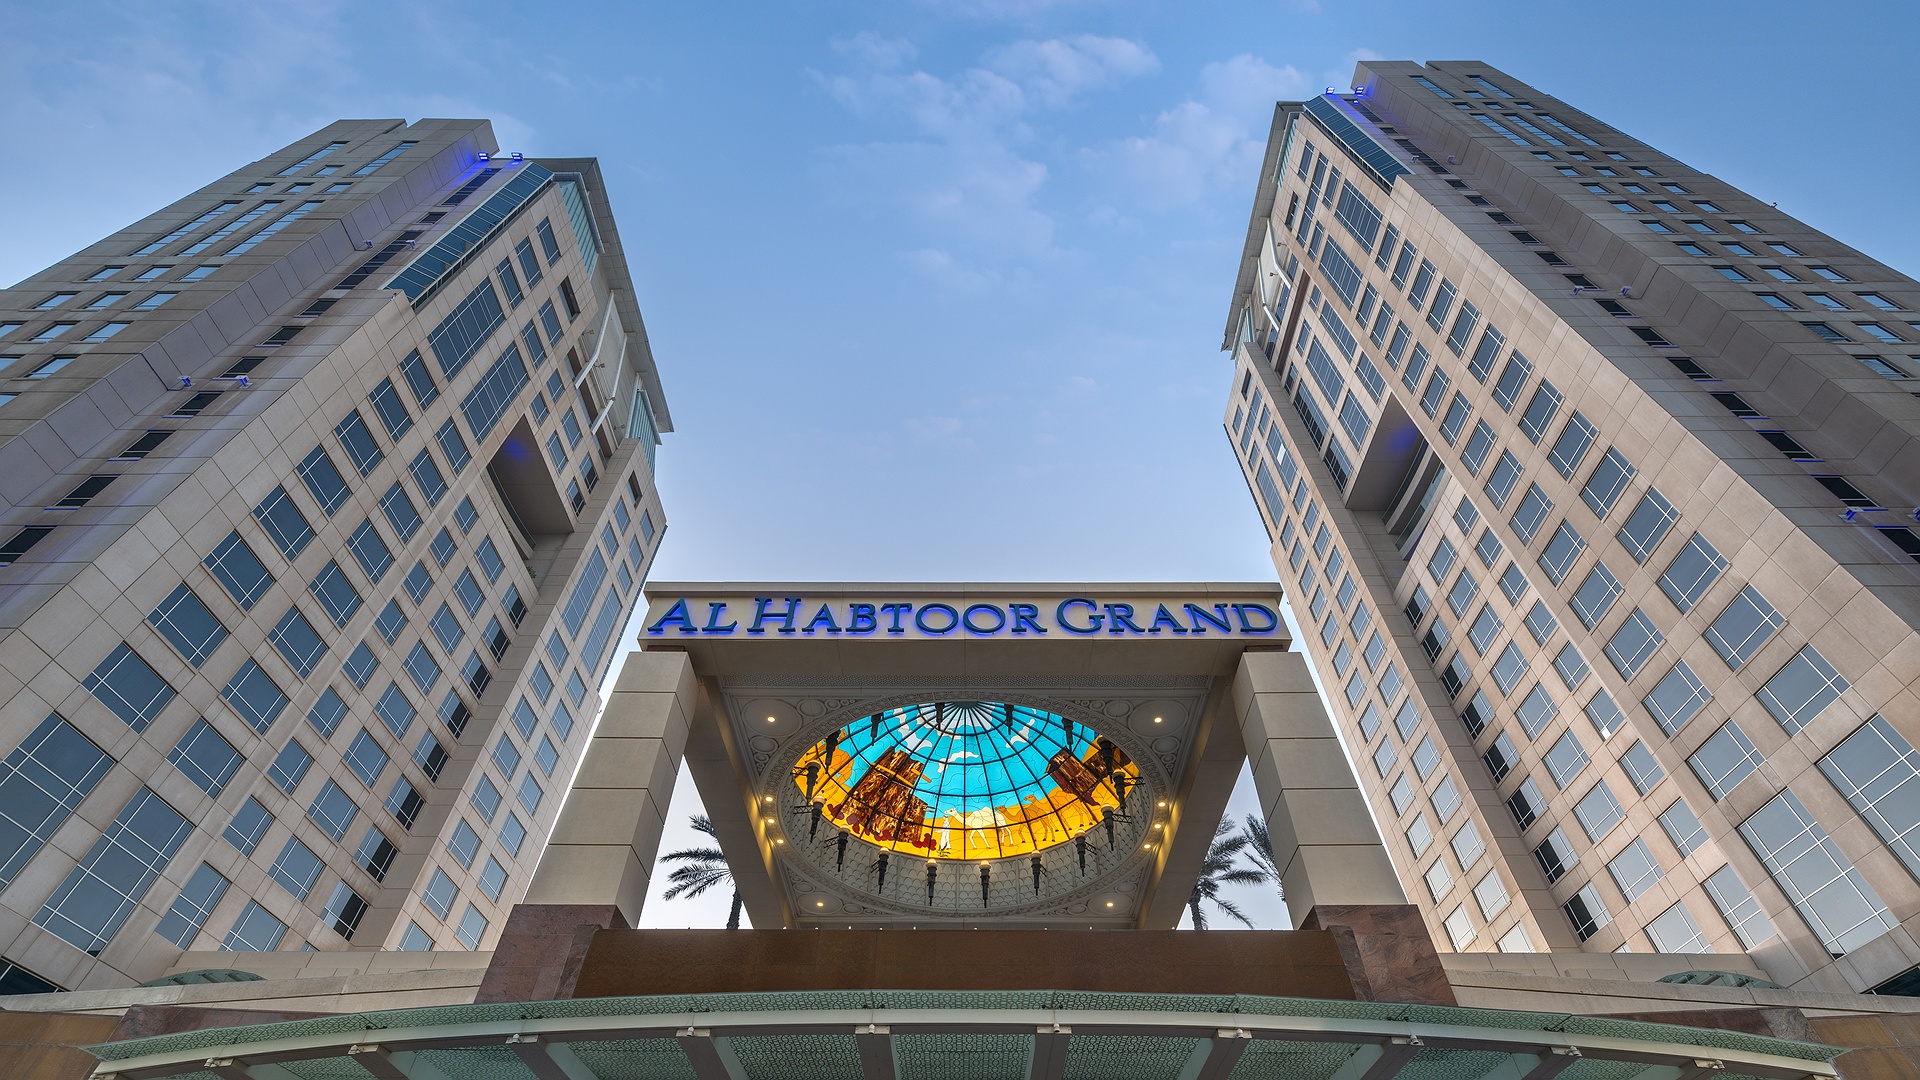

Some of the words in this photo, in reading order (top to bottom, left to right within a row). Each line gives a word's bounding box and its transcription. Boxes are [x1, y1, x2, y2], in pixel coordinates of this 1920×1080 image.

[647, 597, 738, 633] AL
[747, 597, 1048, 634] HABTOOR
[1056, 597, 1279, 634] GRAND
